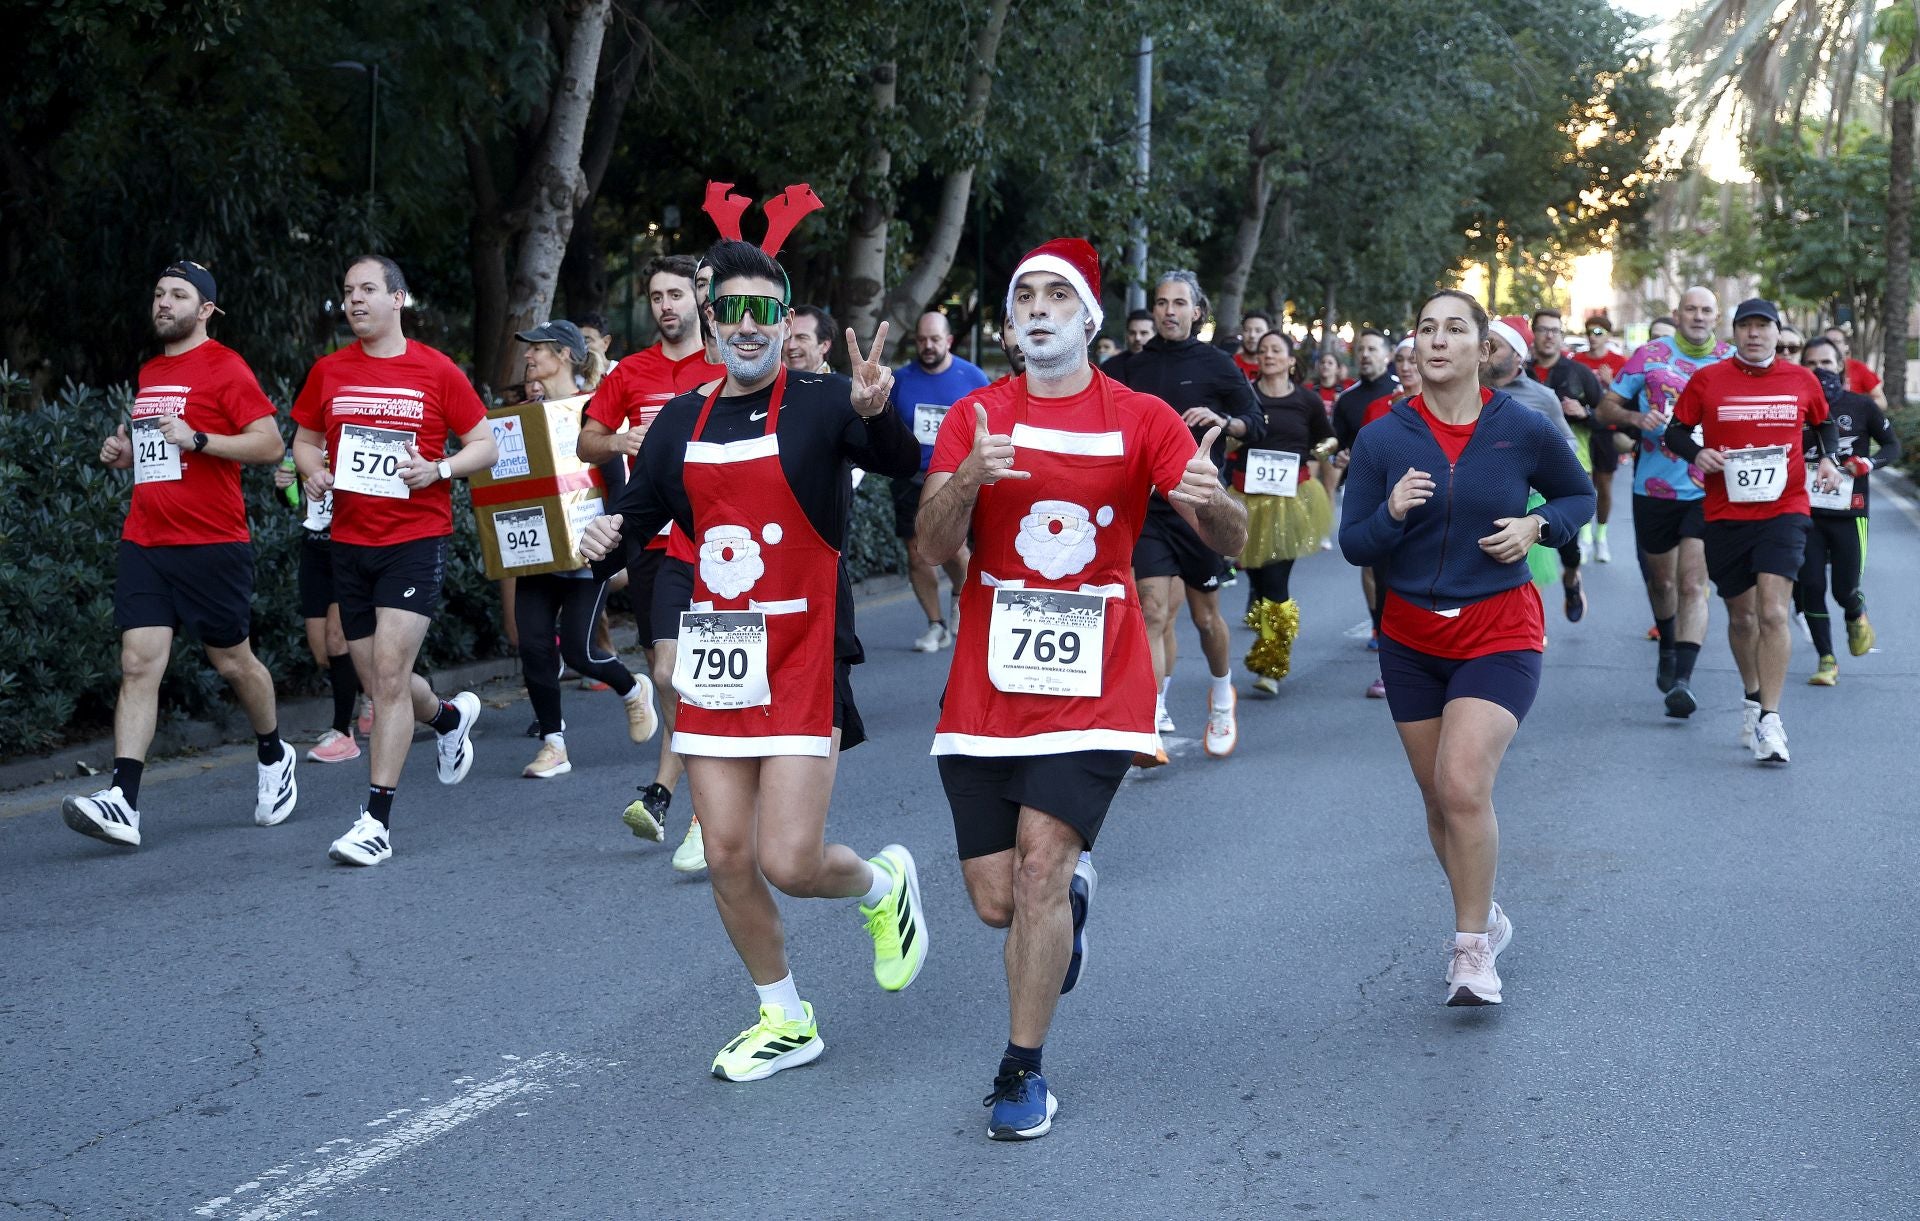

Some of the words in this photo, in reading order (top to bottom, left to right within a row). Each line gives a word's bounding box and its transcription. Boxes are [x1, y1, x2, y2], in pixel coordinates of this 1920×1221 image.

[352, 407, 382, 416] PALMA
[383, 408, 424, 420] PALMILLA
[387, 399, 424, 407] CARRERA
[139, 440, 168, 463] 241
[351, 451, 399, 477] 570
[1256, 466, 1288, 482] 917
[1737, 467, 1776, 487] 877
[507, 528, 540, 550] 942
[1066, 607, 1101, 616] XIV
[1011, 628, 1081, 665] 769
[692, 648, 748, 680] 790
